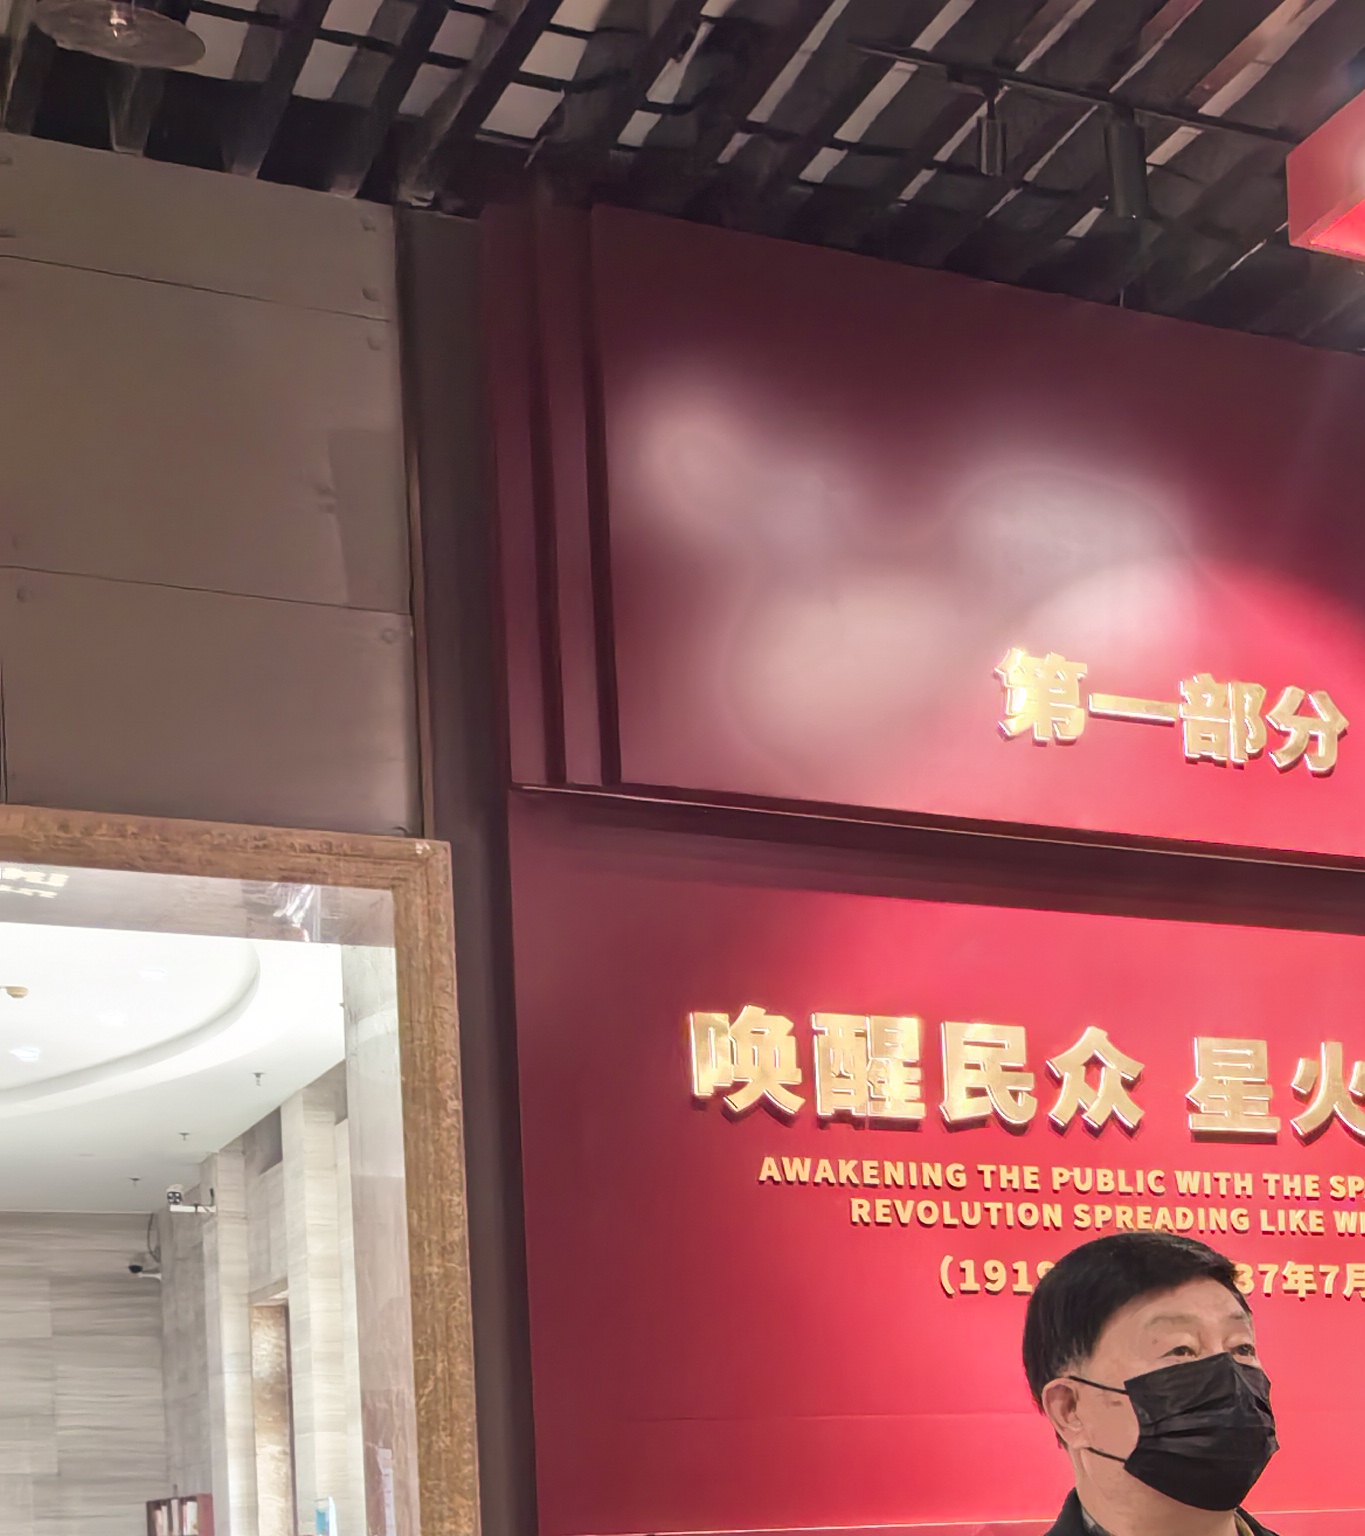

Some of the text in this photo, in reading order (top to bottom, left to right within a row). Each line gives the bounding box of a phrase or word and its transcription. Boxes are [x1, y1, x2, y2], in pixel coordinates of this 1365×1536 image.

[993, 647, 1350, 777] 第一部分
[688, 1004, 1146, 1134] 唤醒民众
[758, 1157, 968, 1189] AWAKENING
[977, 1163, 1041, 1190] THE
[1051, 1166, 1167, 1195] PUBLIC
[1174, 1170, 1254, 1199] WITH
[1263, 1173, 1321, 1201] THE
[850, 1197, 1063, 1229] REVOLUTION
[1073, 1202, 1250, 1234] SPREADING
[1259, 1208, 1326, 1236] LIKE
